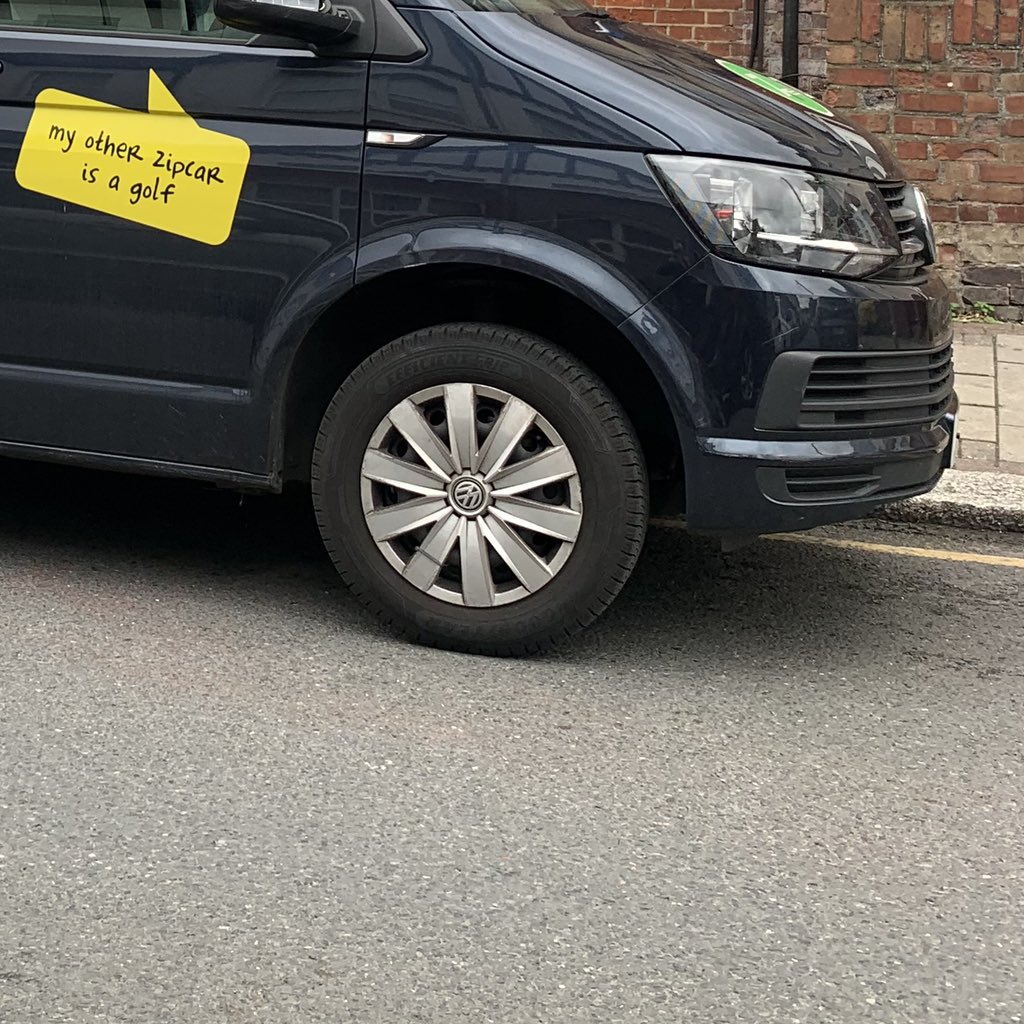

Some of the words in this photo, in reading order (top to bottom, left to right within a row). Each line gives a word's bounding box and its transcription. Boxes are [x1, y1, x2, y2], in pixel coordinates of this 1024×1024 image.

[48, 124, 77, 153] my
[81, 163, 100, 183] is
[108, 175, 120, 192] a
[129, 176, 176, 205] golf
